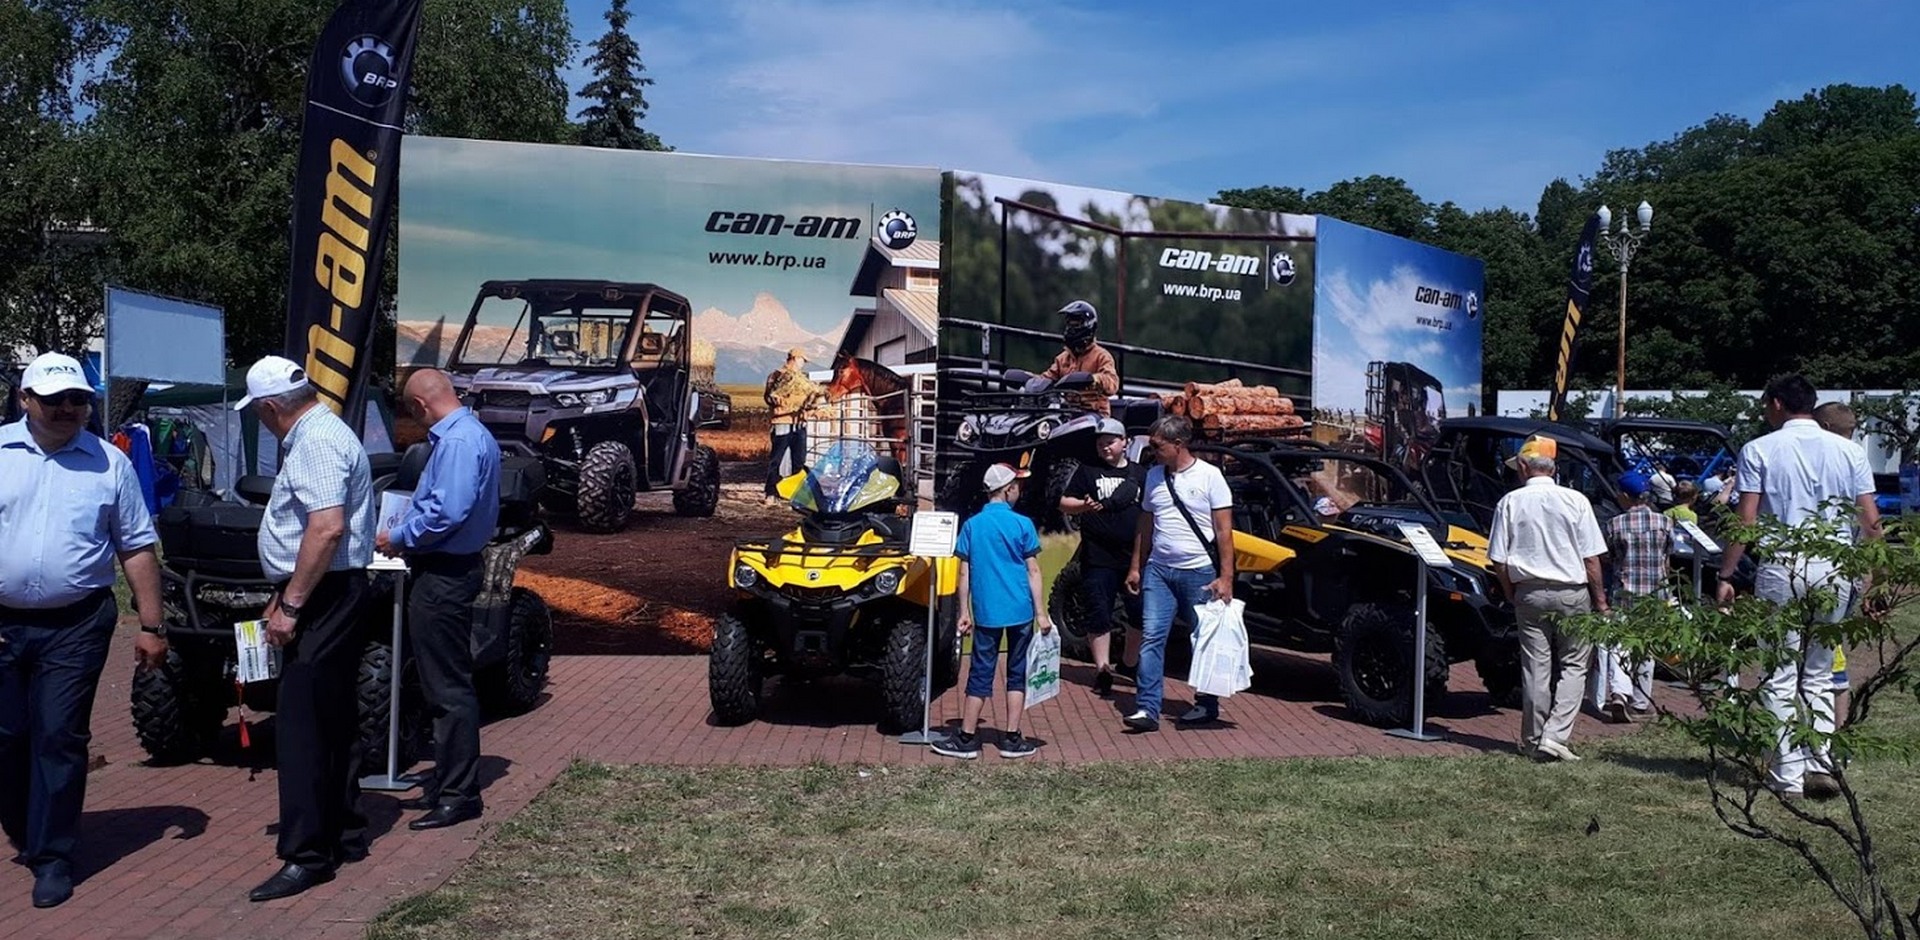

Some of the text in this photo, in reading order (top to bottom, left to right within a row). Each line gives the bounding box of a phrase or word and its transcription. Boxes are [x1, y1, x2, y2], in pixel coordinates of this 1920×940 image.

[363, 72, 397, 89] BRP
[705, 210, 917, 240] can-am BRP
[708, 251, 827, 270] www.brp.ua
[1159, 247, 1260, 275] can-am
[305, 138, 376, 415] n-am
[1163, 283, 1242, 301] www.brp.ua
[1415, 285, 1462, 310] can-am
